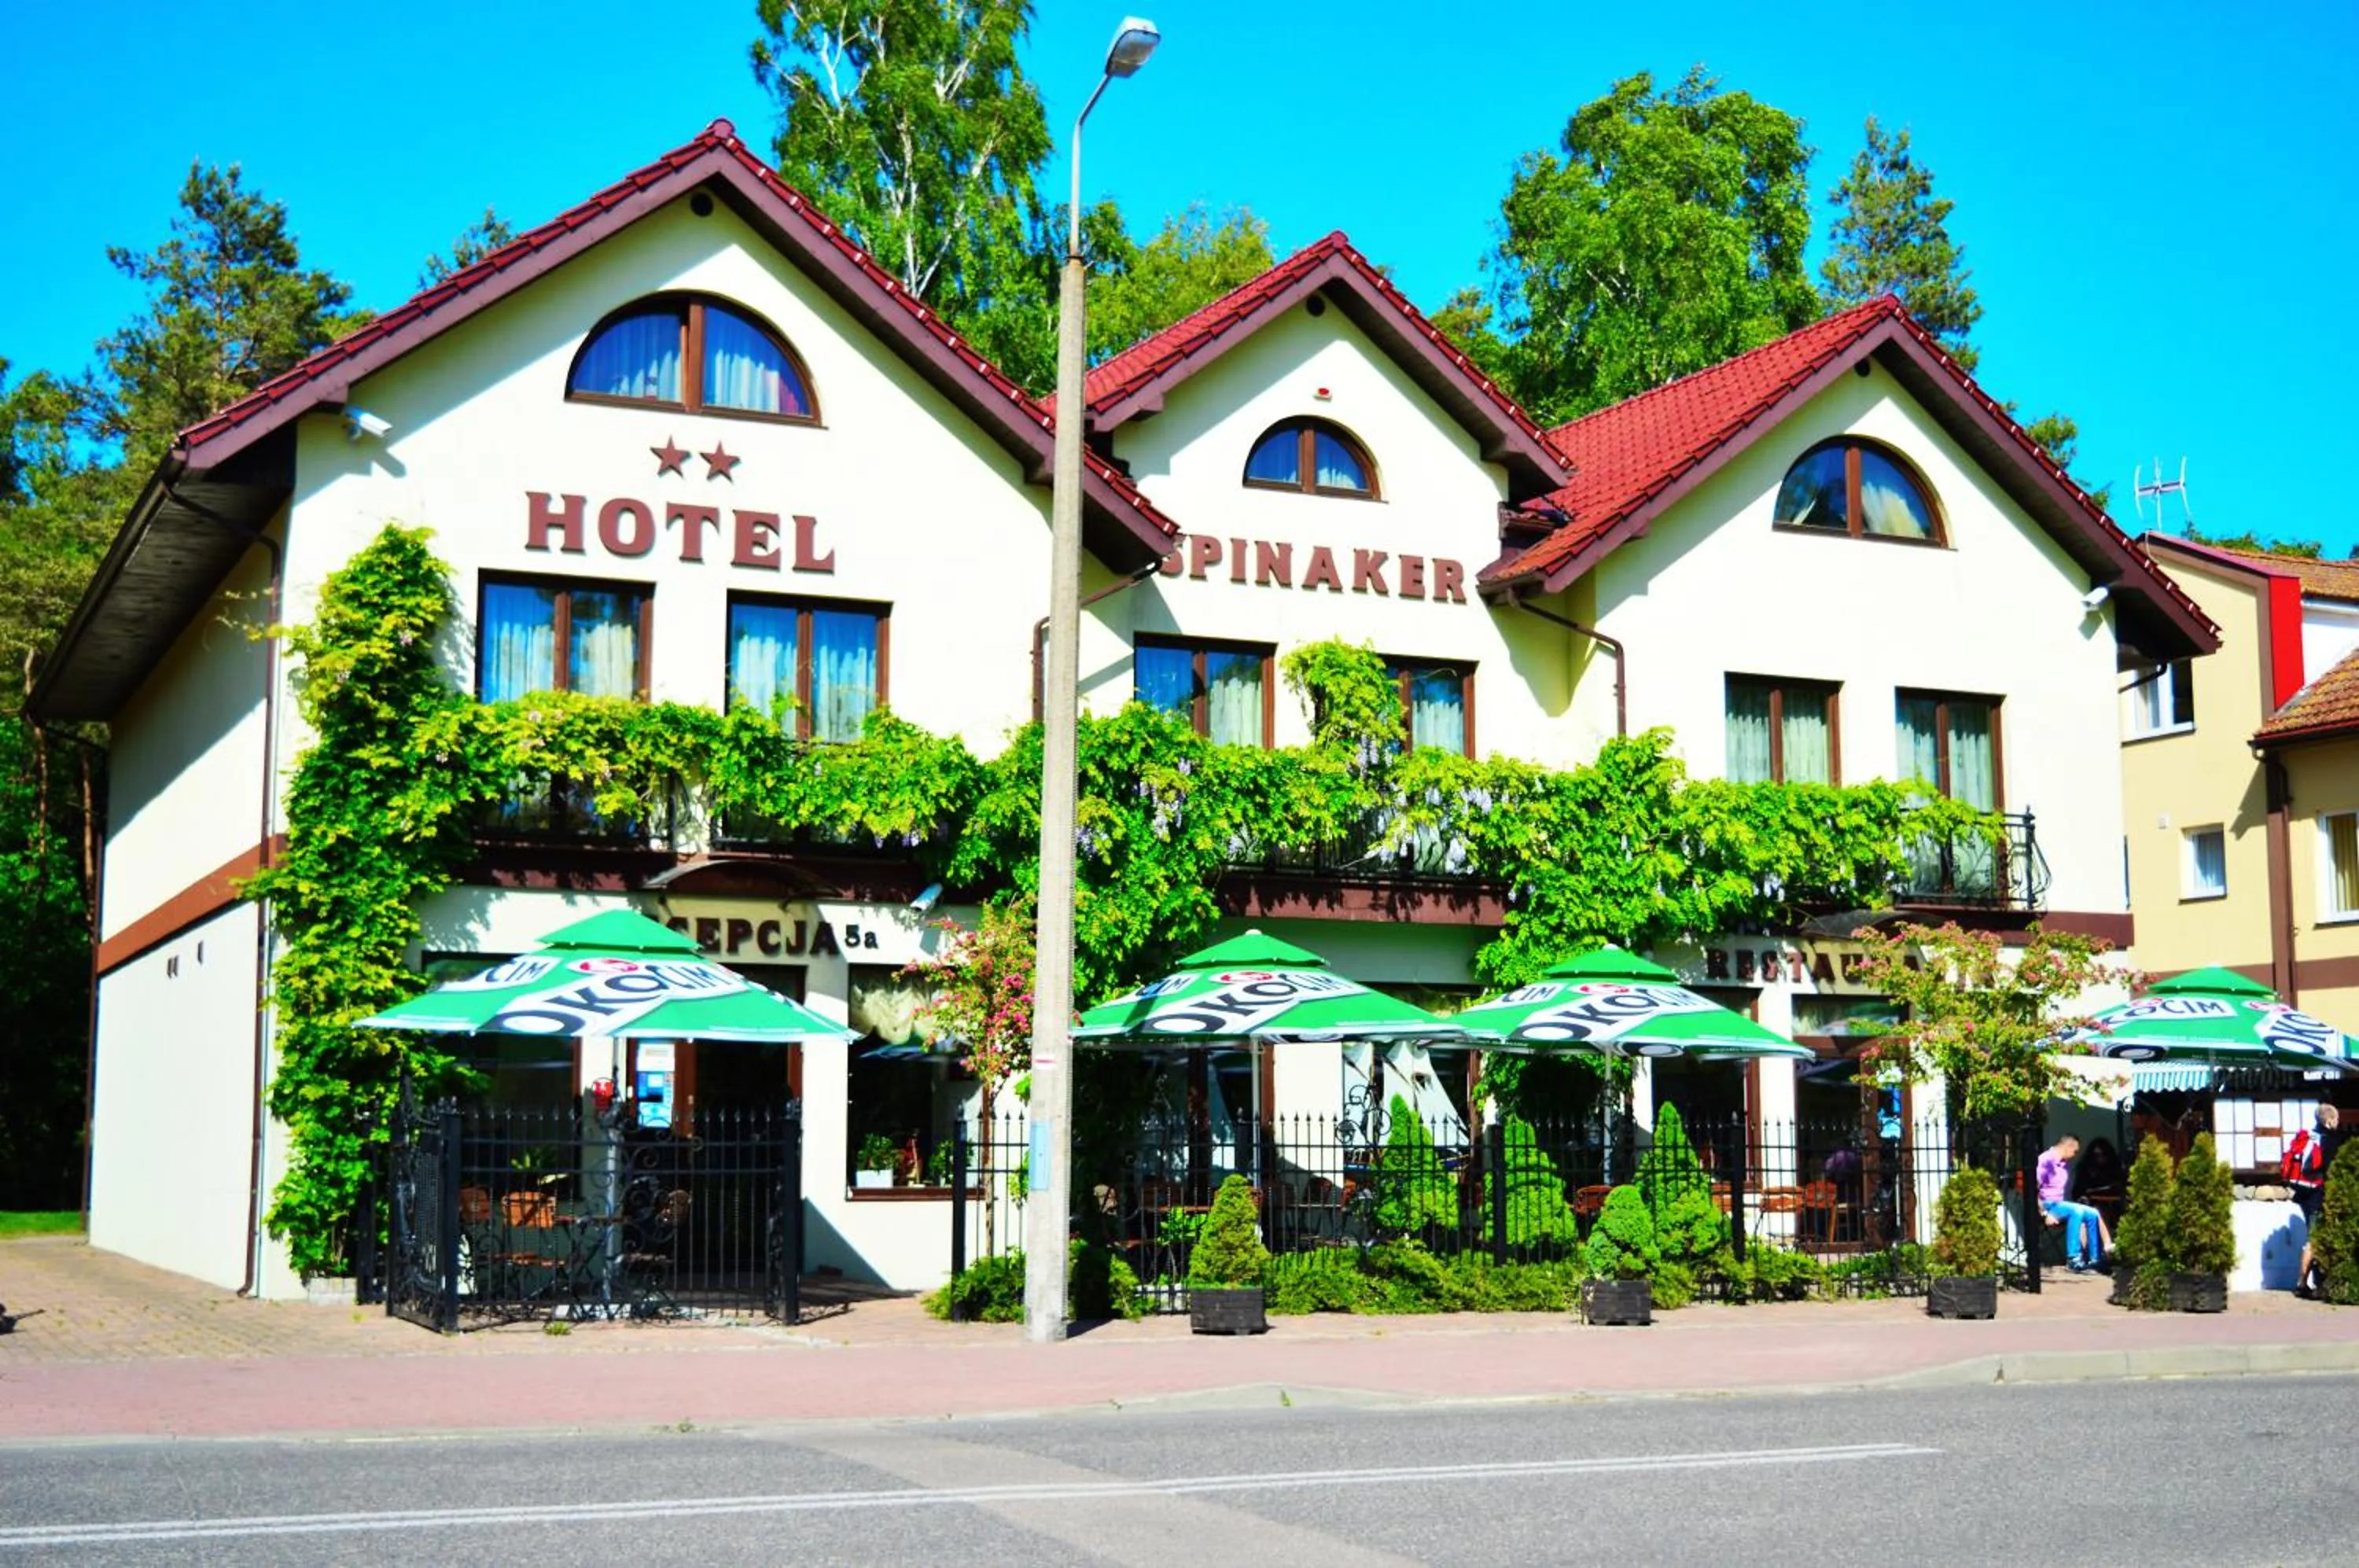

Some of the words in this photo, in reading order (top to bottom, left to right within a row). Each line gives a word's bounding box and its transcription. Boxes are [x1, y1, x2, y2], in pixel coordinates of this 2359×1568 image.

[524, 491, 835, 576] HOTEL
[1160, 533, 1467, 605] SPINAKER
[845, 924, 879, 949] 5a
[484, 957, 551, 982] CIM
[1500, 985, 1558, 1003] CIM
[481, 964, 732, 1036] OKOCIM
[1138, 973, 1352, 1035] OKOCIM
[1506, 987, 1709, 1042] OKOCIM
[2263, 1013, 2335, 1056] OKO
